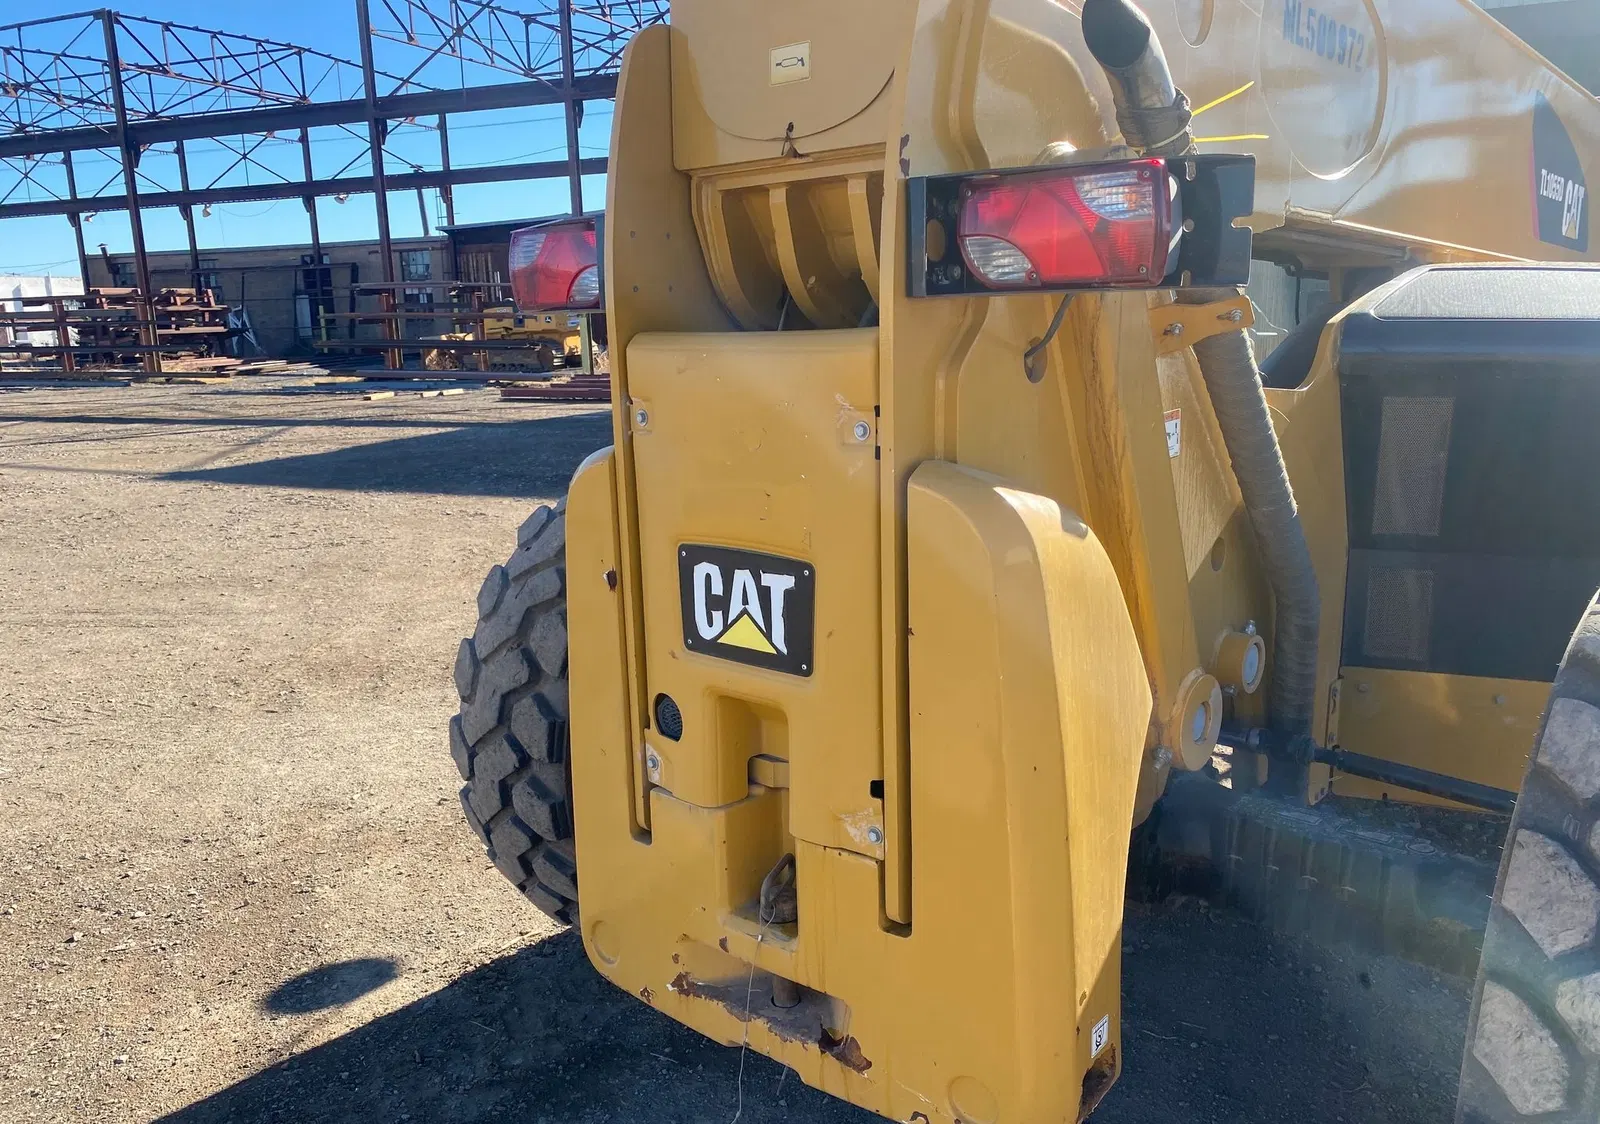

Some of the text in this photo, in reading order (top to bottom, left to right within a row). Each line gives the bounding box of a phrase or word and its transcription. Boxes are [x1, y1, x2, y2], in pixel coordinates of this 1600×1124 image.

[1540, 168, 1565, 202] TL1055D
[1562, 179, 1585, 240] CAT
[693, 561, 796, 655] CAT
